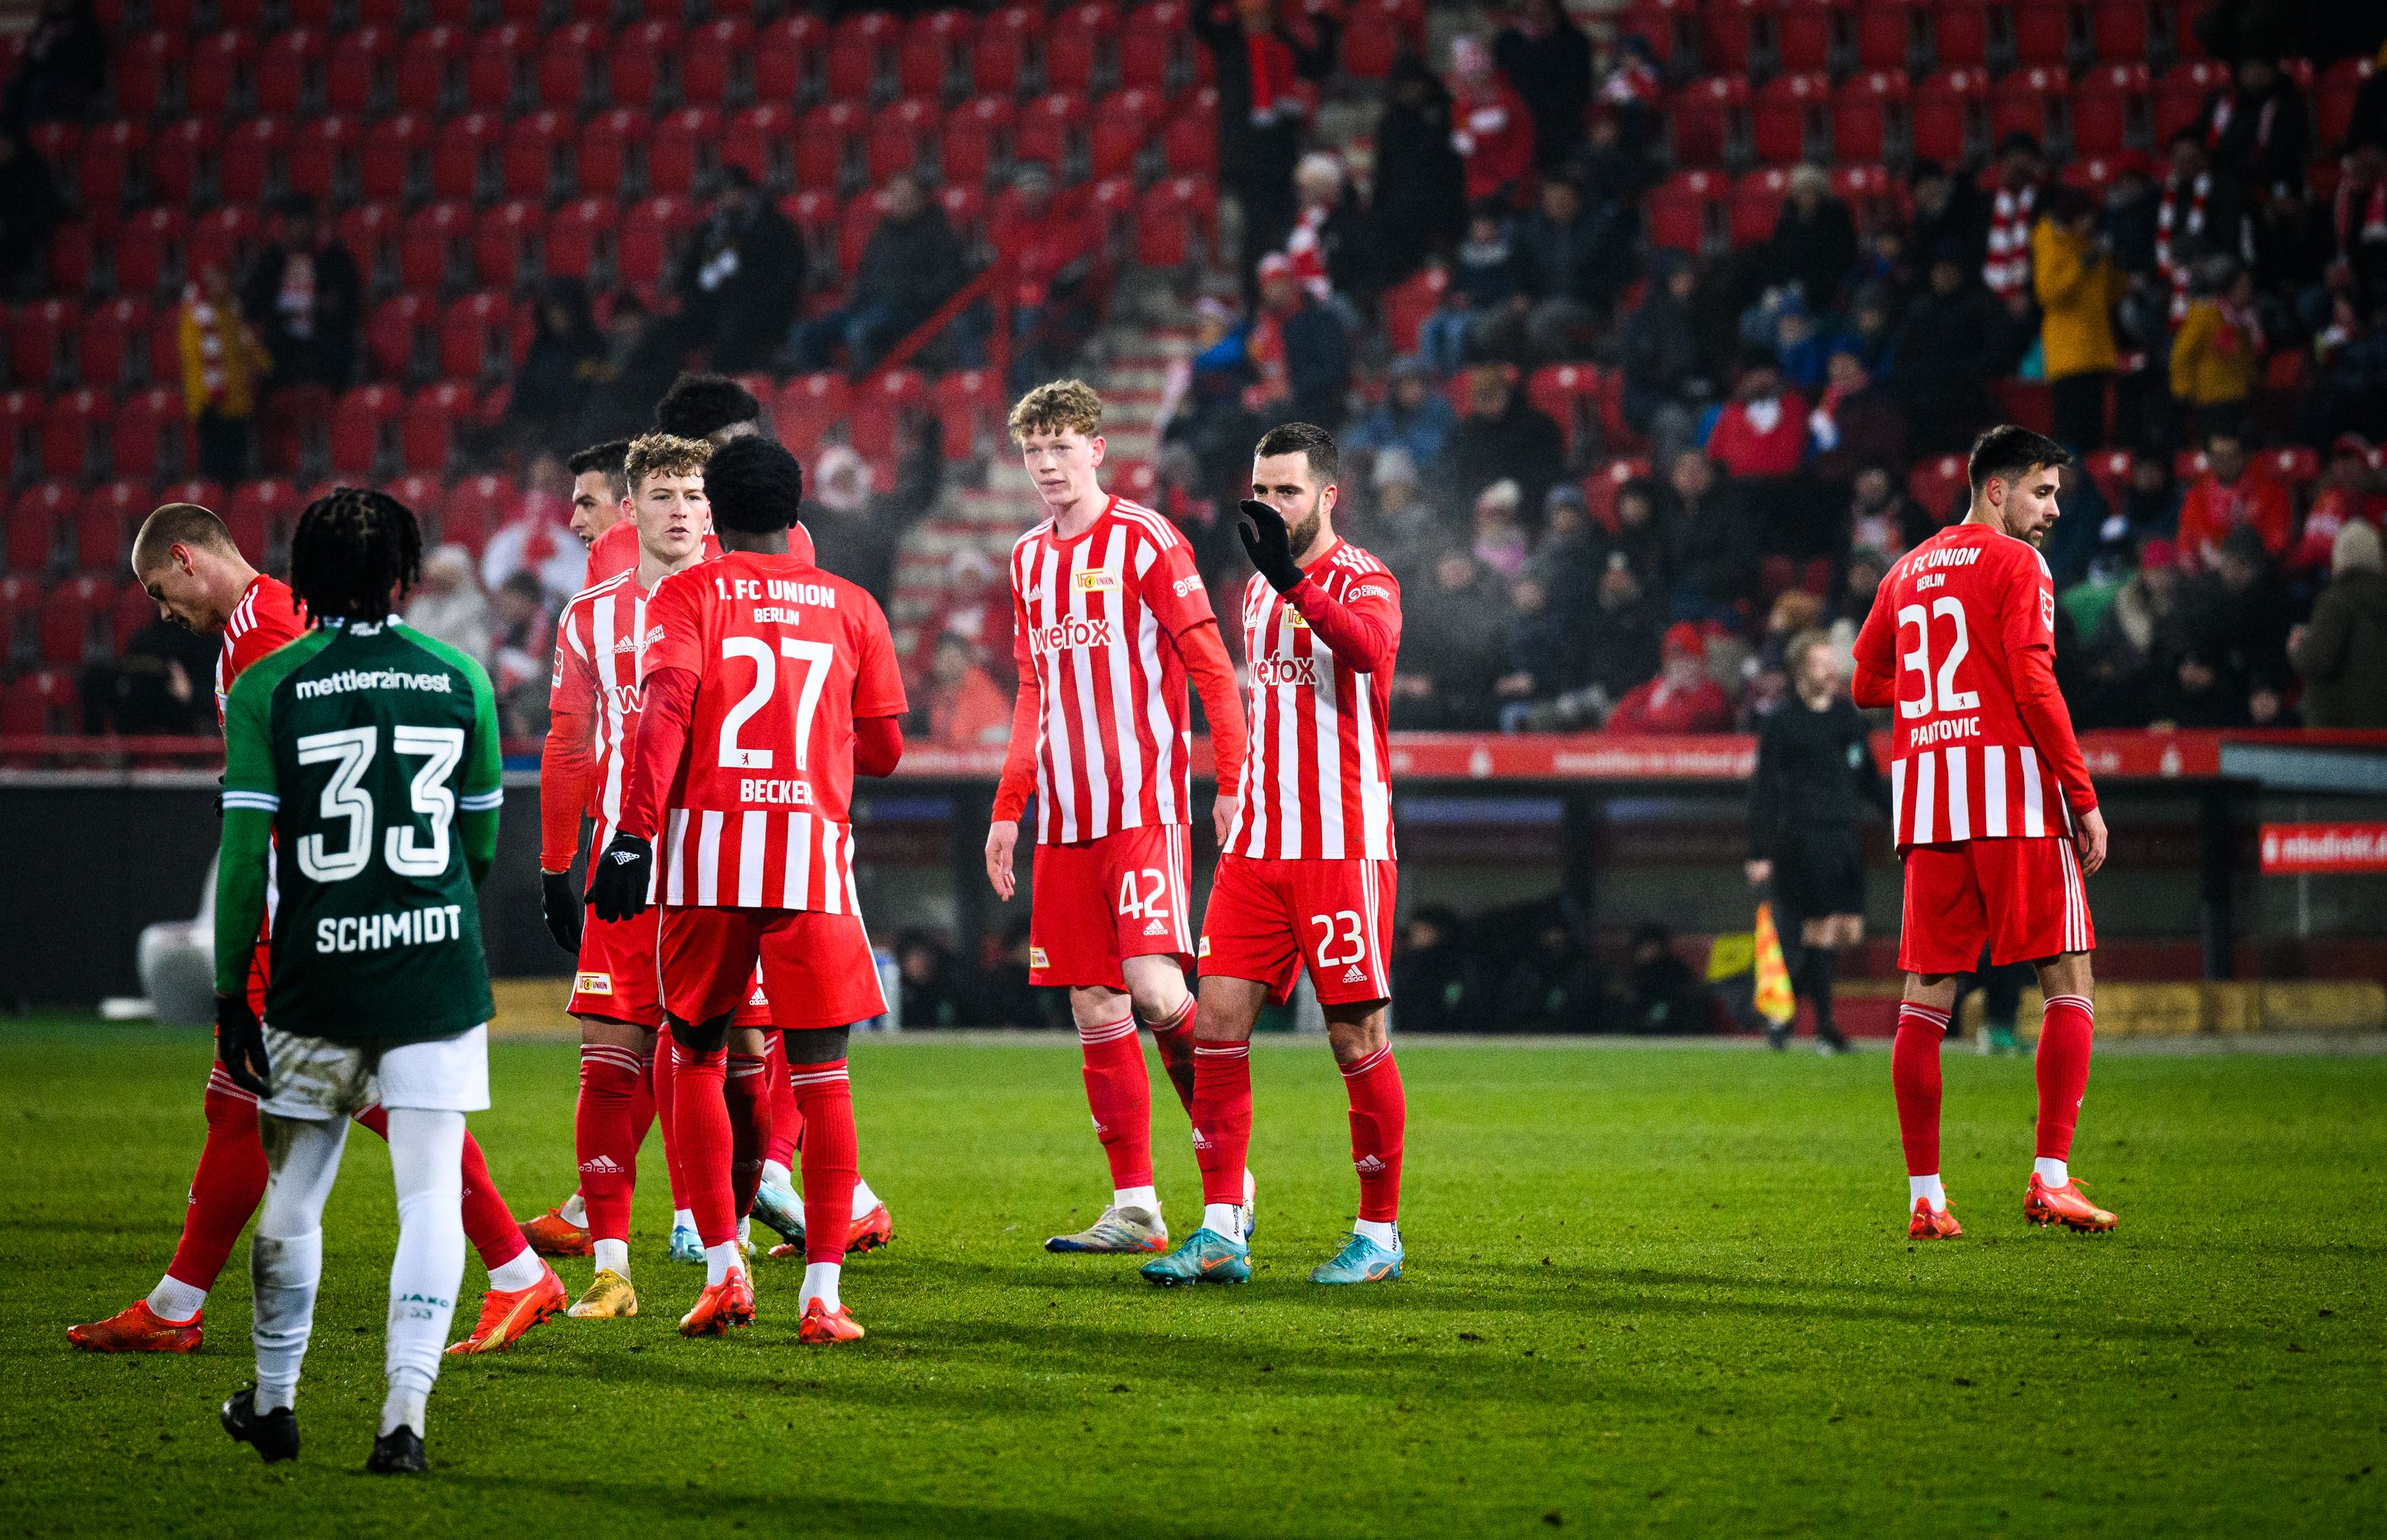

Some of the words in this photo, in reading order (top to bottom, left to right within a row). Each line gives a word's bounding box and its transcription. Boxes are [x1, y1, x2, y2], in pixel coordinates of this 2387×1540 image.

[1900, 562, 1909, 581] 1.
[1910, 553, 1929, 575] FC
[1927, 547, 1981, 568] UNION
[715, 578, 732, 601] 1.
[734, 579, 761, 601] FC
[766, 579, 835, 609] UNION
[1916, 573, 1945, 593] BERLIN
[753, 607, 800, 626] BERLIN
[1032, 613, 1112, 653] wefox
[611, 645, 639, 655] adidas
[1898, 596, 1981, 719] 32
[718, 636, 834, 772] 27
[296, 725, 465, 883] 33
[740, 778, 814, 806] BECKER
[1119, 868, 1169, 920] 42
[316, 904, 461, 954] SCHMIDT
[1310, 910, 1366, 968] 23
[1342, 975, 1368, 984] adidas
[578, 1164, 625, 1173] adidas
[399, 1293, 450, 1308] JAKO
[142, 1329, 177, 1340] ULTRA
